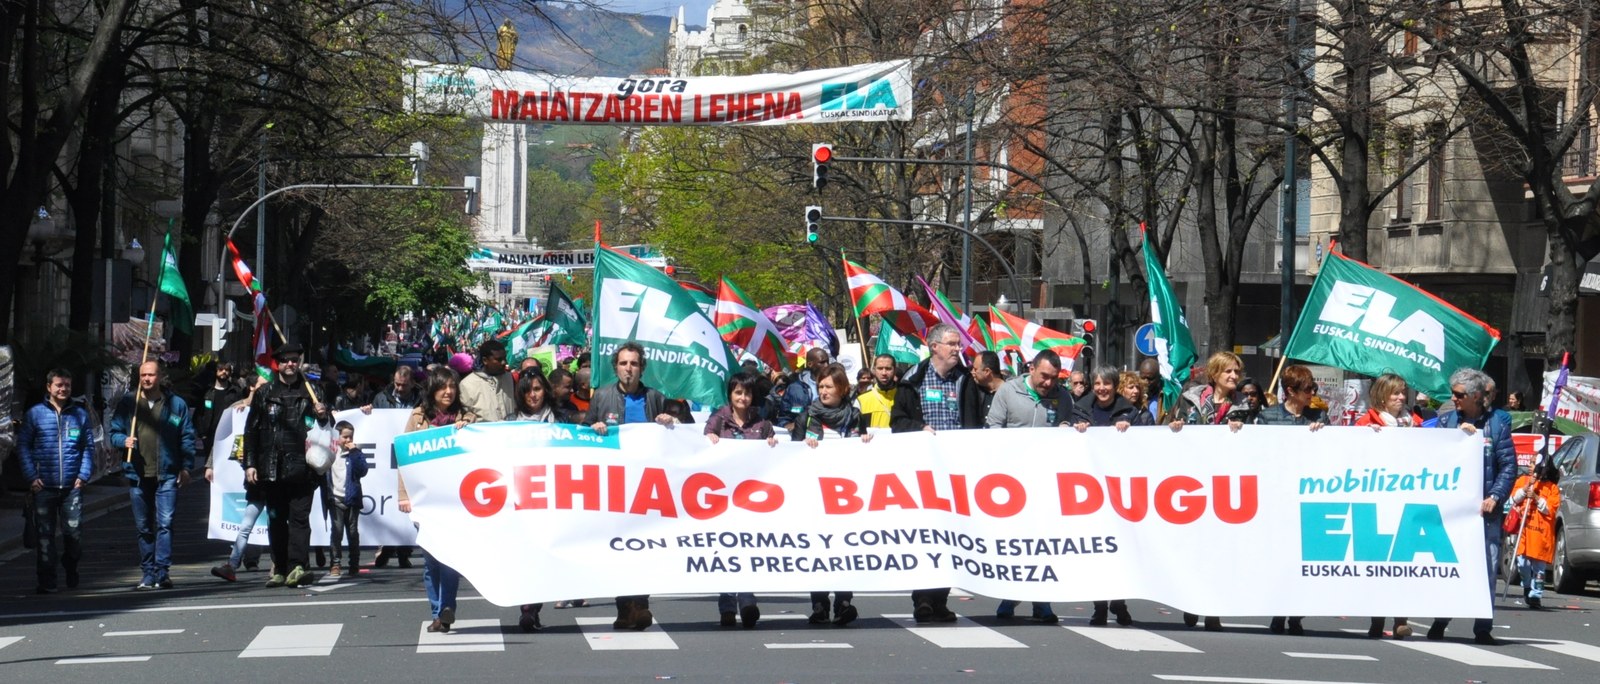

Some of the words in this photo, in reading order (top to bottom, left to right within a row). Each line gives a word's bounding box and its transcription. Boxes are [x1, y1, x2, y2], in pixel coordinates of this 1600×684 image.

[617, 78, 688, 100] gora
[820, 79, 899, 110] ELA
[491, 89, 682, 123] MAIATZAREN
[694, 92, 804, 122] LEHENA
[821, 110, 850, 118] EUSKAL
[852, 109, 899, 117] SINDIKATUA
[498, 253, 574, 265] MAIATZAREN
[601, 277, 729, 370] ELA
[1318, 280, 1445, 363] ELA
[1313, 324, 1360, 343] EUSKAL
[1363, 336, 1441, 371] SINDIKATUA
[643, 347, 725, 381] SINDIKATUA
[577, 433, 604, 443] 2016
[459, 464, 785, 520] GEHIAGO
[818, 470, 1027, 518] BALIO
[1056, 472, 1258, 524] DUGU
[1299, 466, 1462, 495] mobilizatu!
[609, 536, 667, 551] CON
[676, 531, 811, 549] REFORMAS
[818, 533, 834, 549] Y
[843, 528, 987, 554] CONVENIOS
[995, 535, 1119, 556] ESTATALES
[1300, 502, 1459, 563] ELA
[686, 550, 742, 573] MÁS
[750, 552, 919, 573] PRECARIEDAD
[926, 552, 943, 569] Y
[951, 556, 1059, 583] POBREZA
[1301, 565, 1361, 577] EUSKAL
[1366, 565, 1461, 579] SINDIKATUA
